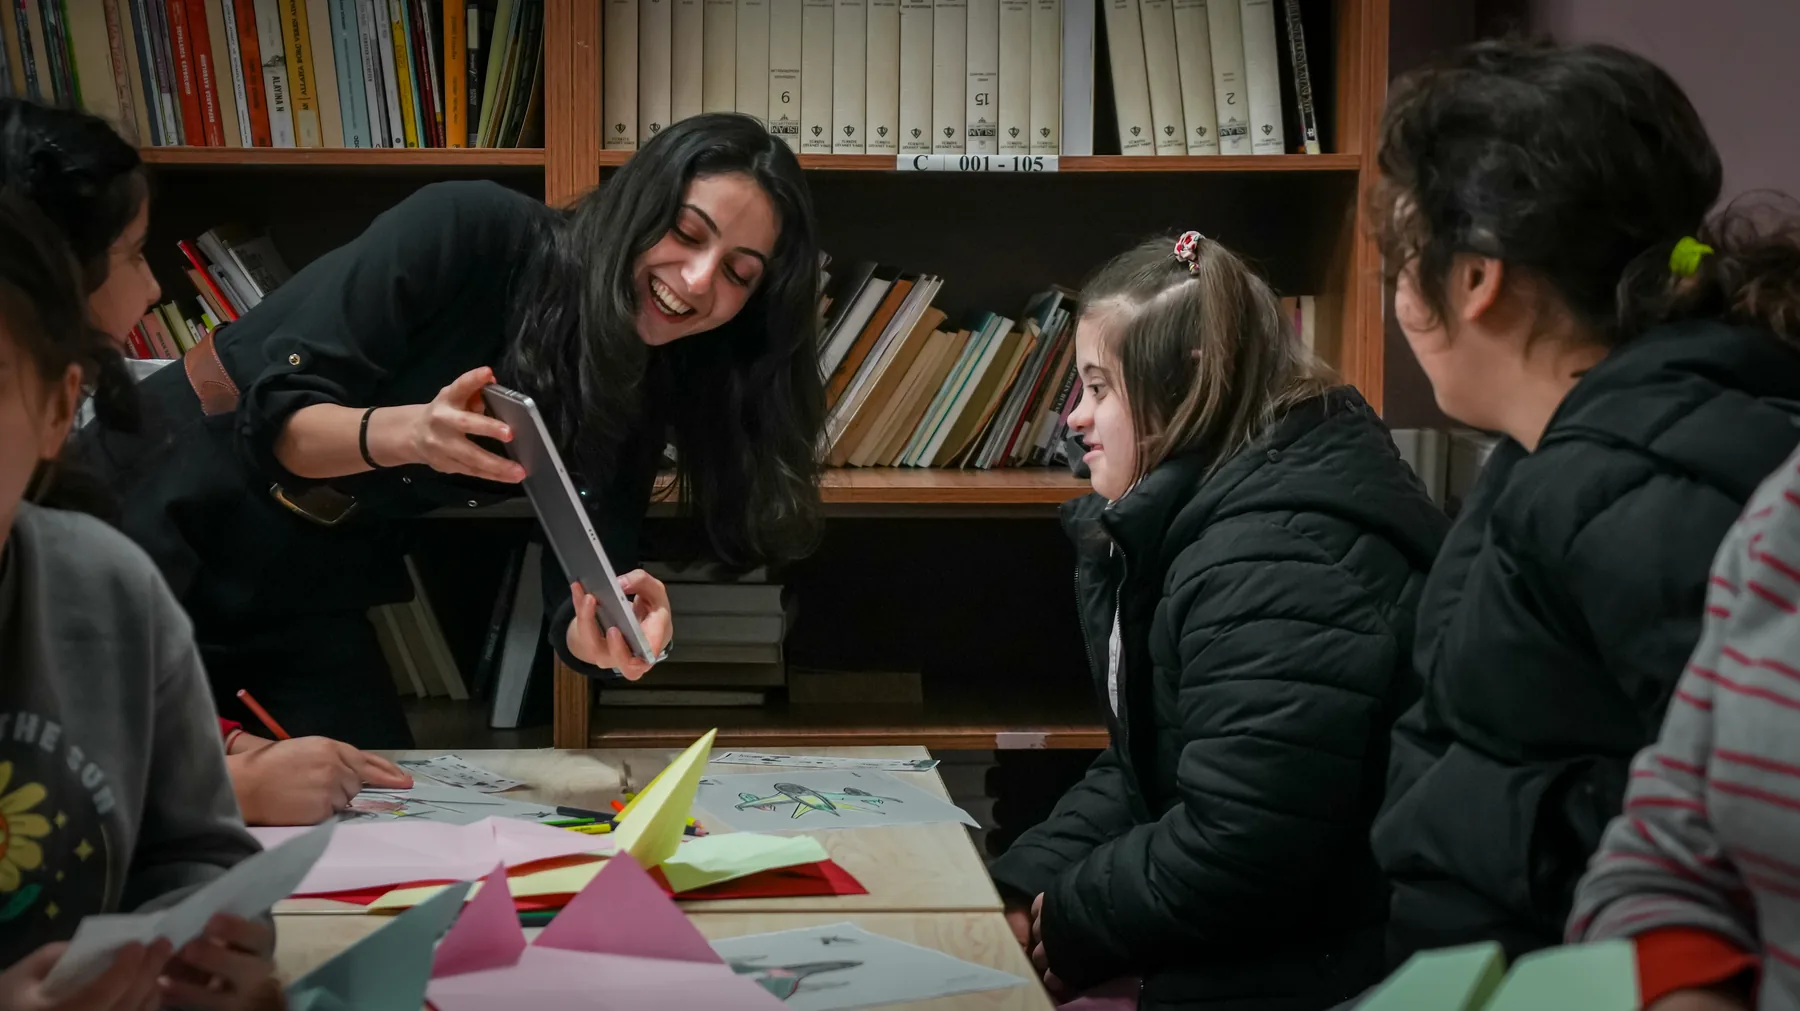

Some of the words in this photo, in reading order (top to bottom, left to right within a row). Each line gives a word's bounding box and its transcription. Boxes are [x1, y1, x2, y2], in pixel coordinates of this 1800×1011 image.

[272, 76, 283, 105] ALAYINA
[975, 93, 989, 106] 15
[1226, 92, 1236, 105] 2
[913, 155, 929, 171] C
[959, 156, 989, 171] 001
[1013, 156, 1044, 171] 105
